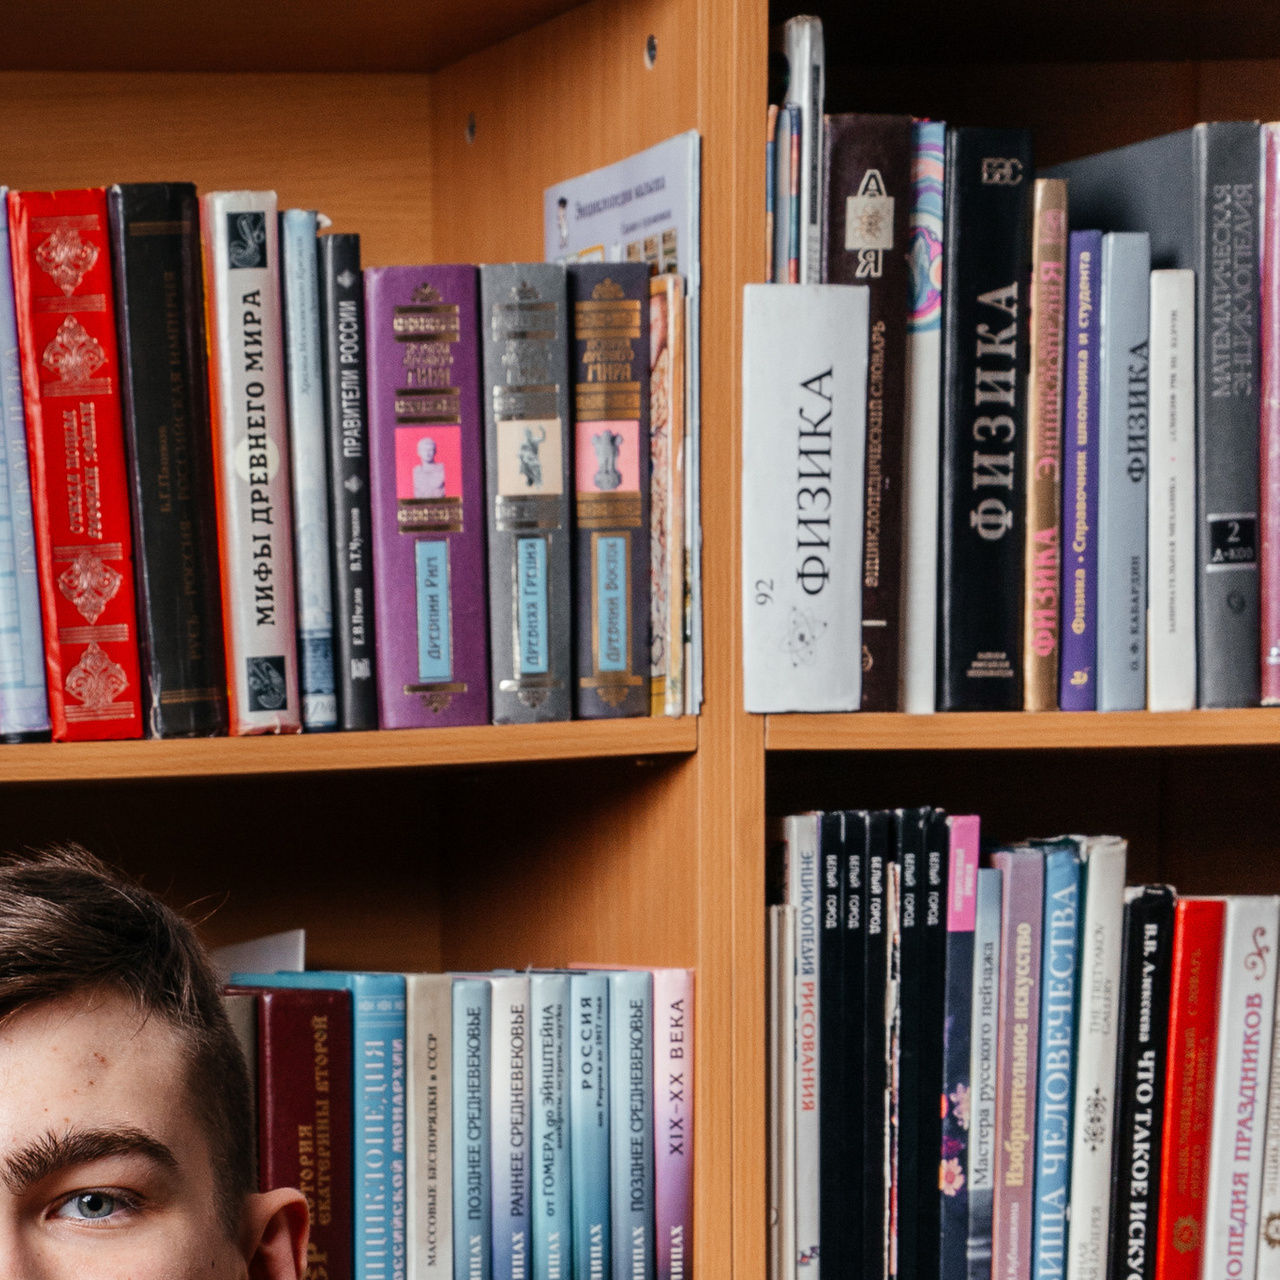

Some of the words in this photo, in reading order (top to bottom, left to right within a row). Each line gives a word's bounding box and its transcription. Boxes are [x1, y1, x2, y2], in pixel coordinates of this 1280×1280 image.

[241, 290, 264, 372] МИРА
[338, 301, 359, 363] РОССИИ
[342, 369, 363, 457] ПРАВИТЕЛИ
[971, 282, 1018, 541] ФИЗИКА
[1073, 350, 1091, 445] школьника
[1127, 340, 1149, 483] ФИЗИКА
[246, 382, 273, 525] ДРЕВНЕГО
[796, 368, 833, 596] ФИЗИКА
[1072, 451, 1091, 552] Справочник
[251, 534, 276, 626] МИФЫ
[755, 579, 774, 606] 92
[1071, 569, 1088, 633] Физика
[980, 942, 995, 1018] пейзажа
[465, 1006, 481, 1140] СРЕДНЕВЕКОВЬЕ
[539, 1005, 556, 1106] ЭЙНШТЕЙНА
[581, 996, 593, 1089] РОССИЯ
[668, 999, 684, 1060] ВЕКА
[979, 1023, 996, 1102] русского
[1042, 882, 1077, 1176] ЧЕЛОВЕЧЕСТВА
[509, 1004, 525, 1148] СРЕДНЕВЕКОВЬЕ
[1137, 1050, 1155, 1099] ЧТО
[1235, 993, 1263, 1161] ПРАЗДНИКОВ
[466, 1146, 481, 1220] ПОЗДНЕЕ
[510, 1151, 525, 1217] РАННЕЕ
[542, 1131, 556, 1196] ГОМЕРА
[974, 1106, 993, 1184] Мастера
[1132, 1107, 1151, 1196] ТАКОЕ
